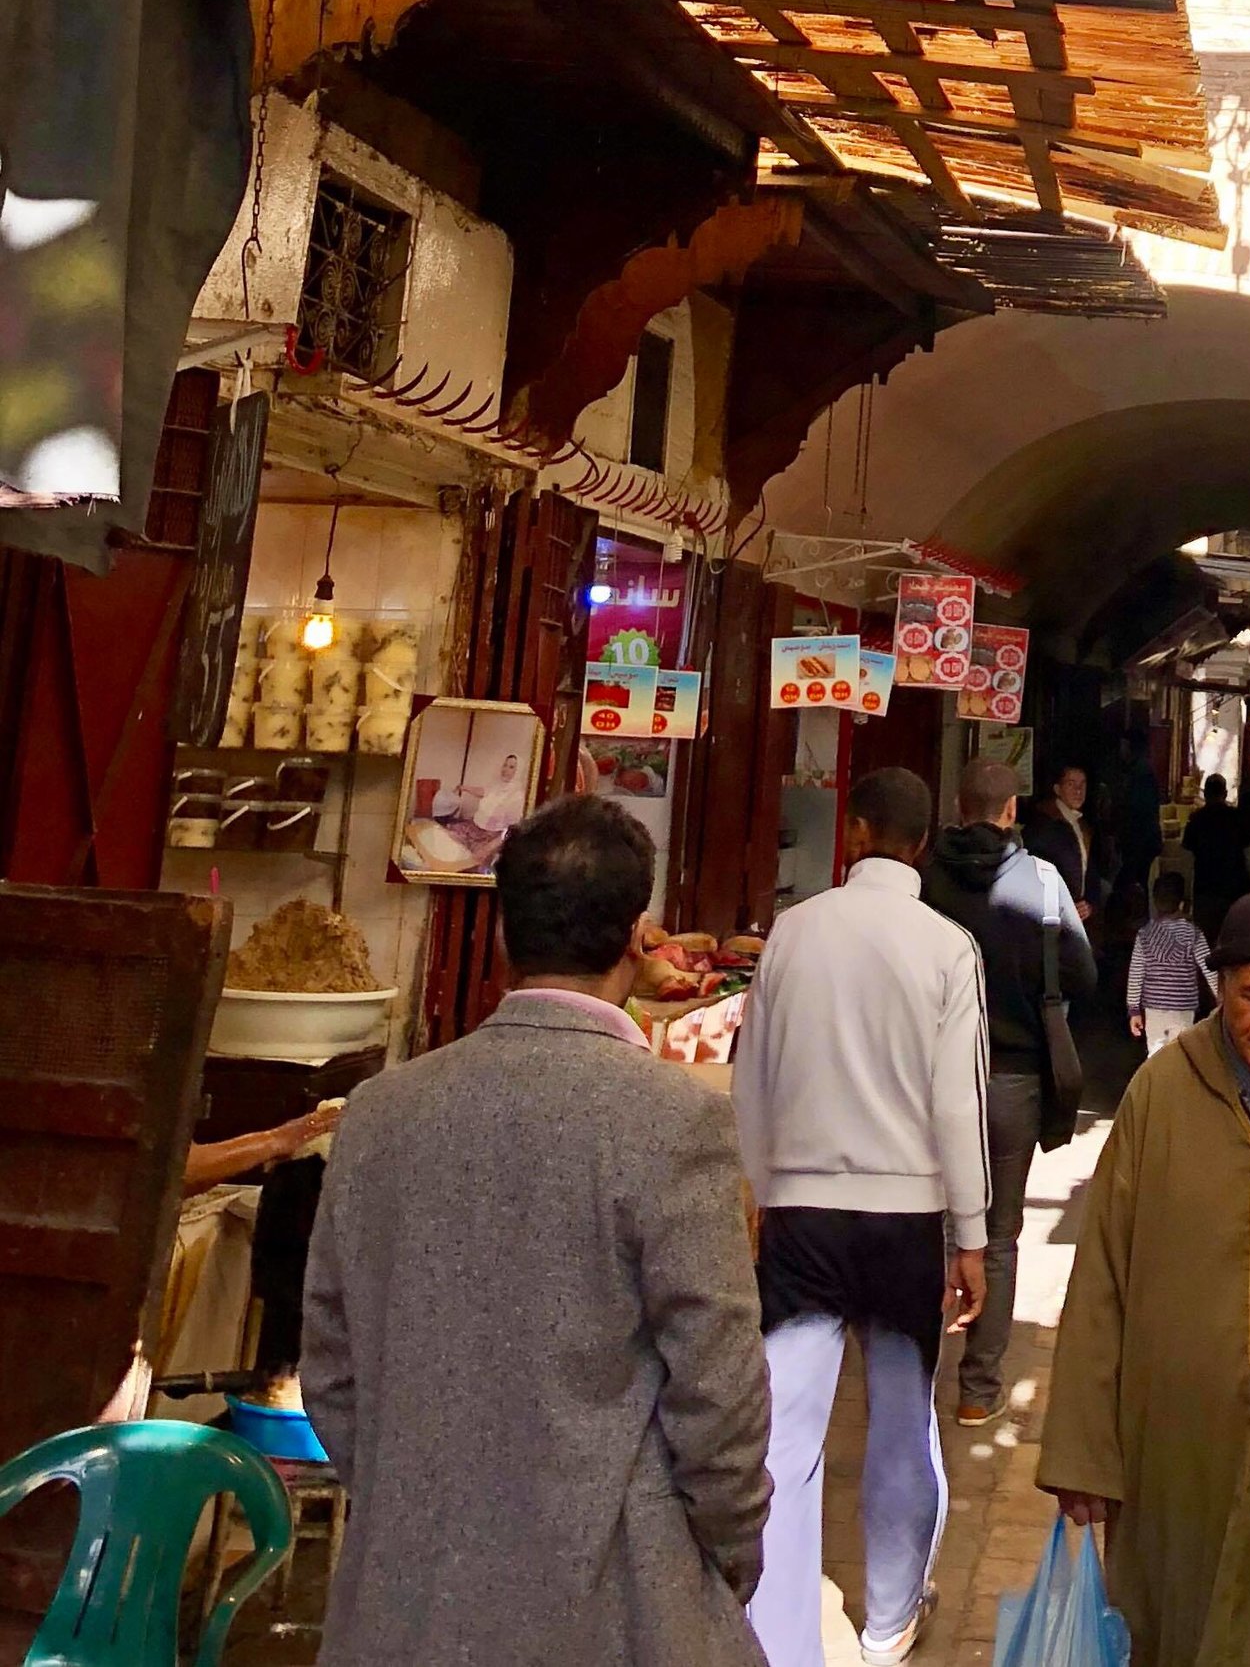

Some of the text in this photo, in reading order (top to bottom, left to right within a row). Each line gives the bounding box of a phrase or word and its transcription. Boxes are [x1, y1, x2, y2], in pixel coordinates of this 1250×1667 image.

[611, 638, 649, 665] 10
[598, 712, 615, 720] 40
[595, 720, 616, 729] DH
